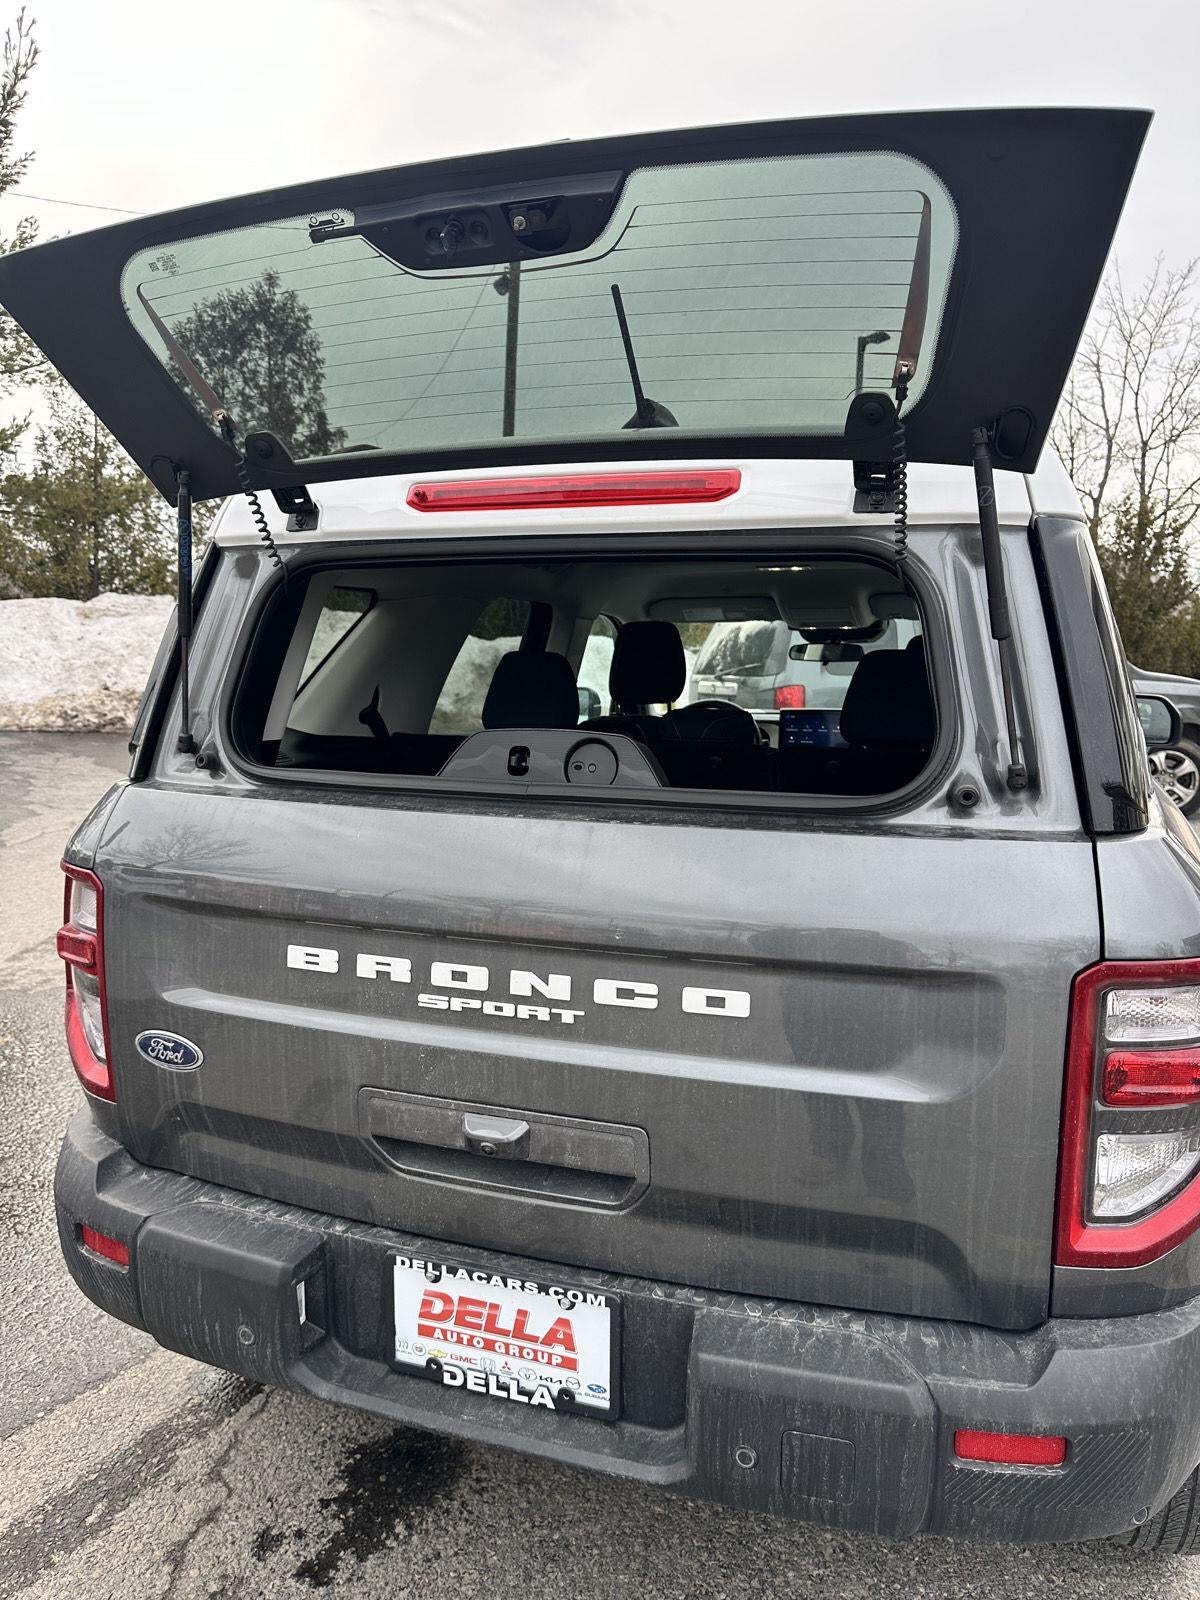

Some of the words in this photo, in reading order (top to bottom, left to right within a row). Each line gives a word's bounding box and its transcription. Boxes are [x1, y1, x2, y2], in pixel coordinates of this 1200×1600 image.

[287, 944, 751, 1018] BRONCO
[417, 993, 586, 1024] SPORT
[147, 1037, 184, 1063] Ford
[394, 1255, 607, 1308] DELLACARS.COM
[418, 1287, 578, 1354] DELLA
[432, 1327, 485, 1350] AUTO
[494, 1341, 564, 1366] GROUP
[449, 1353, 478, 1366] GMC
[442, 1364, 557, 1410] DELLA
